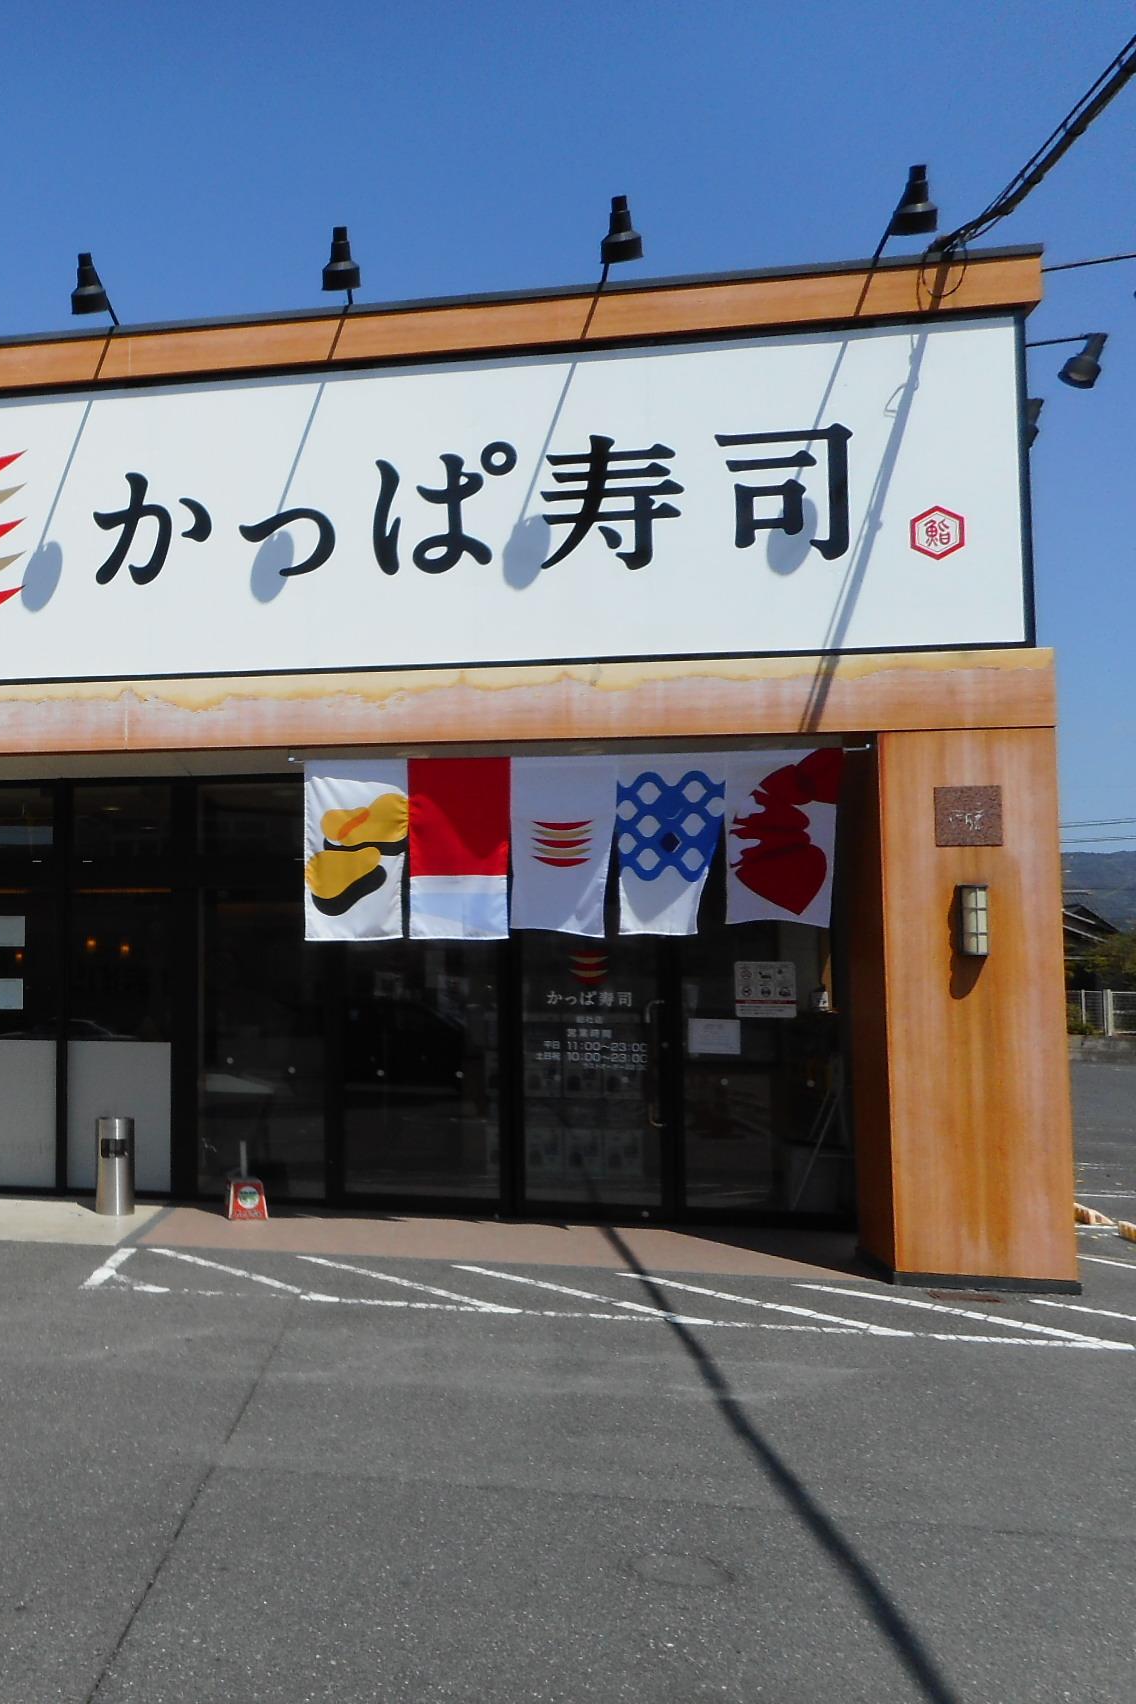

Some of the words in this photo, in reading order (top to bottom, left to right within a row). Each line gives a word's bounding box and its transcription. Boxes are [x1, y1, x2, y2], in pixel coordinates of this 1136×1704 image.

[92, 422, 855, 586] かっぱ寿司
[546, 990, 633, 1008] かっぱ寿司
